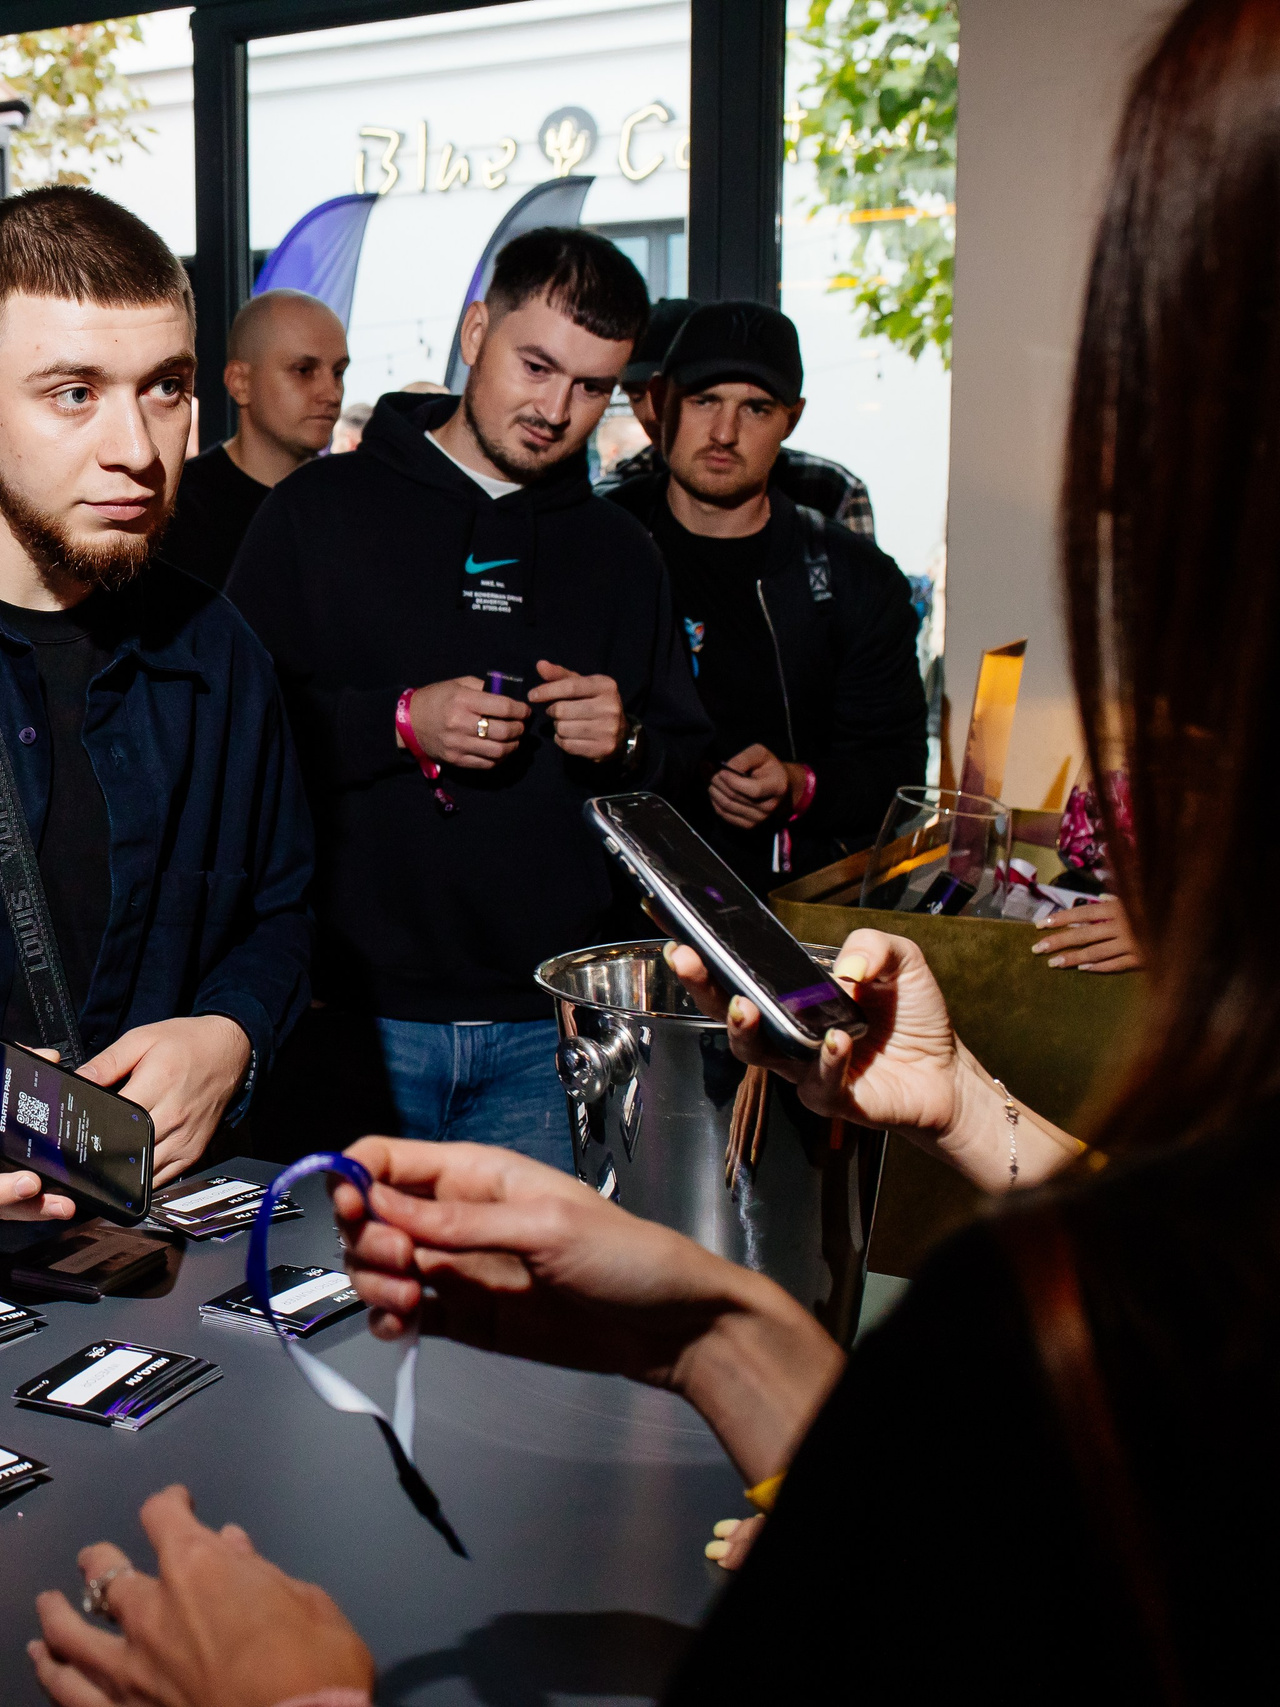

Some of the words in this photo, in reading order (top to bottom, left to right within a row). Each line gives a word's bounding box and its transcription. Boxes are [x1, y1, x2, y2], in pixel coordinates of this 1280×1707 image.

[355, 119, 517, 195] Blue
[397, 699, 407, 723] PRO
[4, 1068, 12, 1091] PASS
[0, 1091, 10, 1133] STARTER
[227, 1196, 243, 1204] I'M
[251, 1203, 288, 1215] HEO,
[234, 1211, 251, 1219] I'M
[137, 1356, 170, 1380] HELLO,
[124, 1374, 142, 1387] I'M
